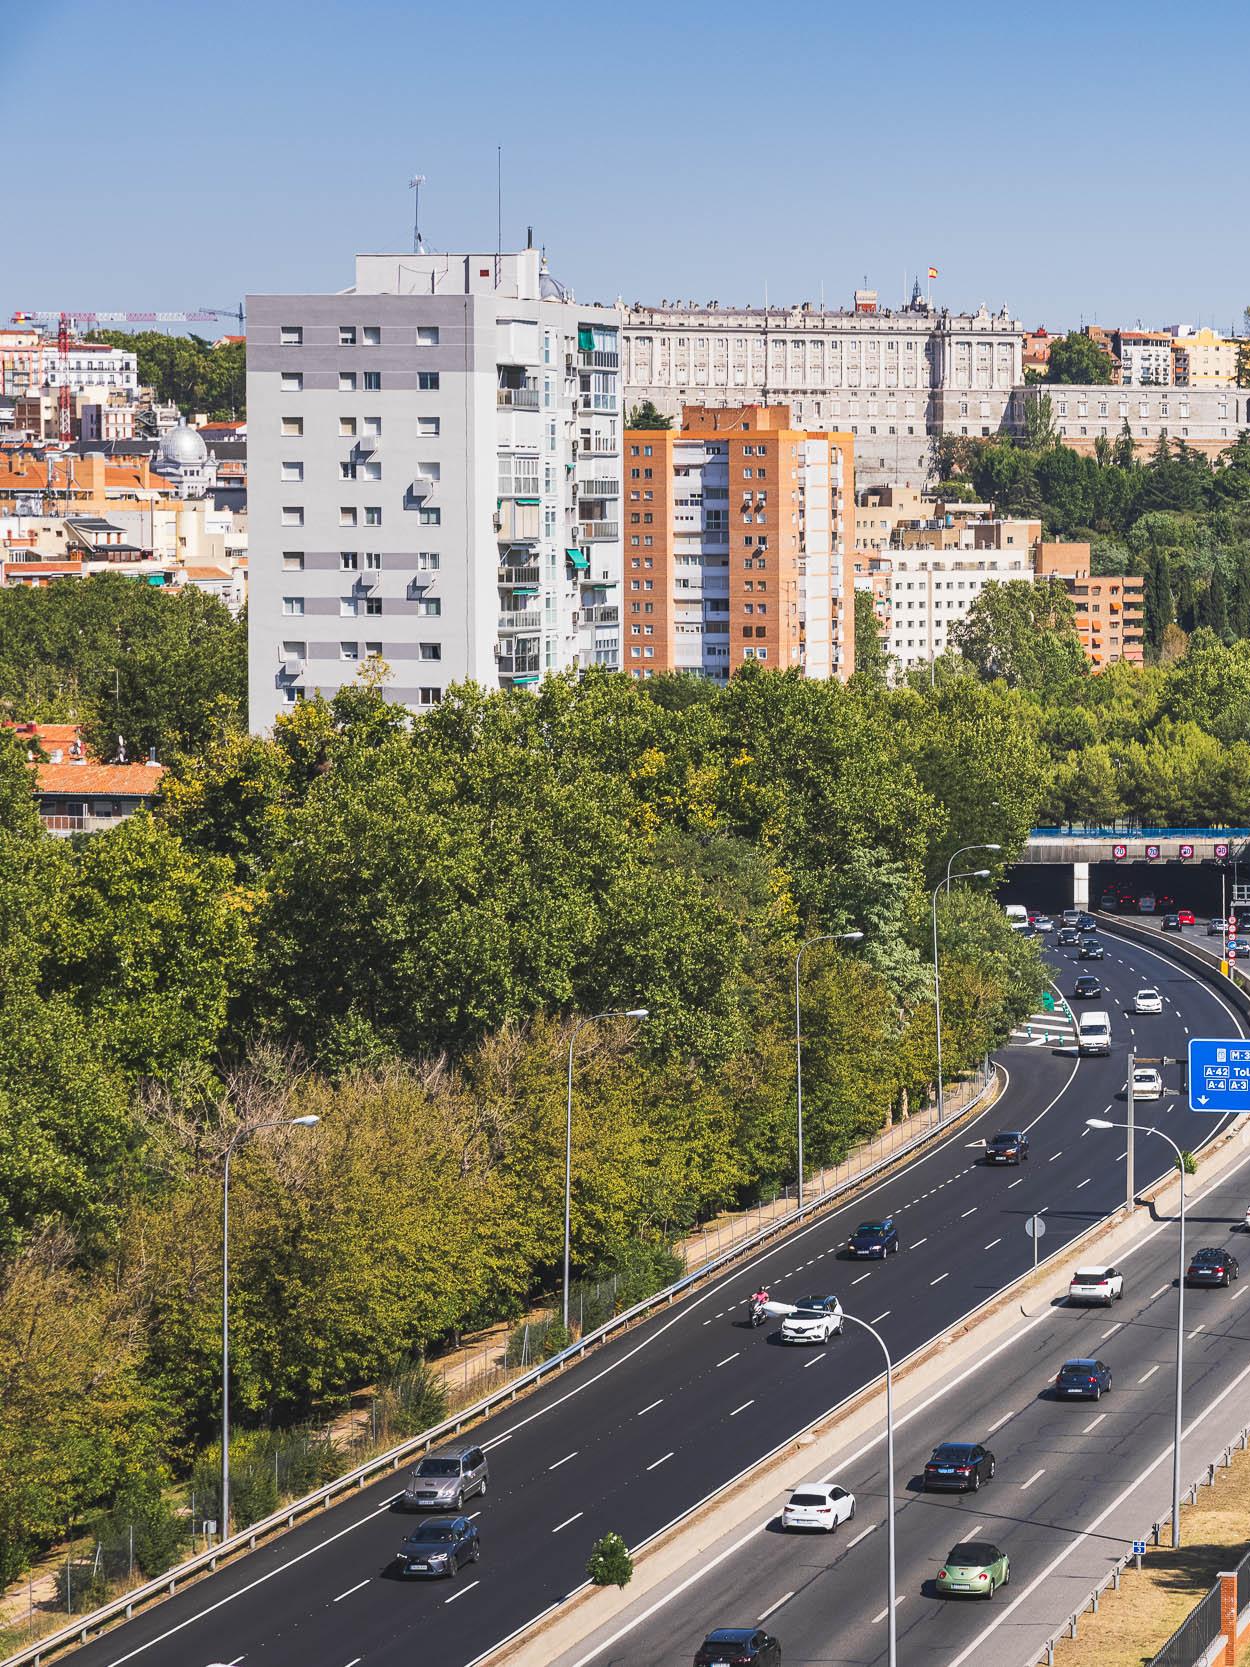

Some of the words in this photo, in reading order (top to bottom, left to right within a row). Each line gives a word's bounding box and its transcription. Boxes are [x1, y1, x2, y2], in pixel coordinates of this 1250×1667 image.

[1205, 1068, 1228, 1076] A-42
[1208, 1080, 1225, 1089] A-4
[1230, 1081, 1247, 1089] A-3
